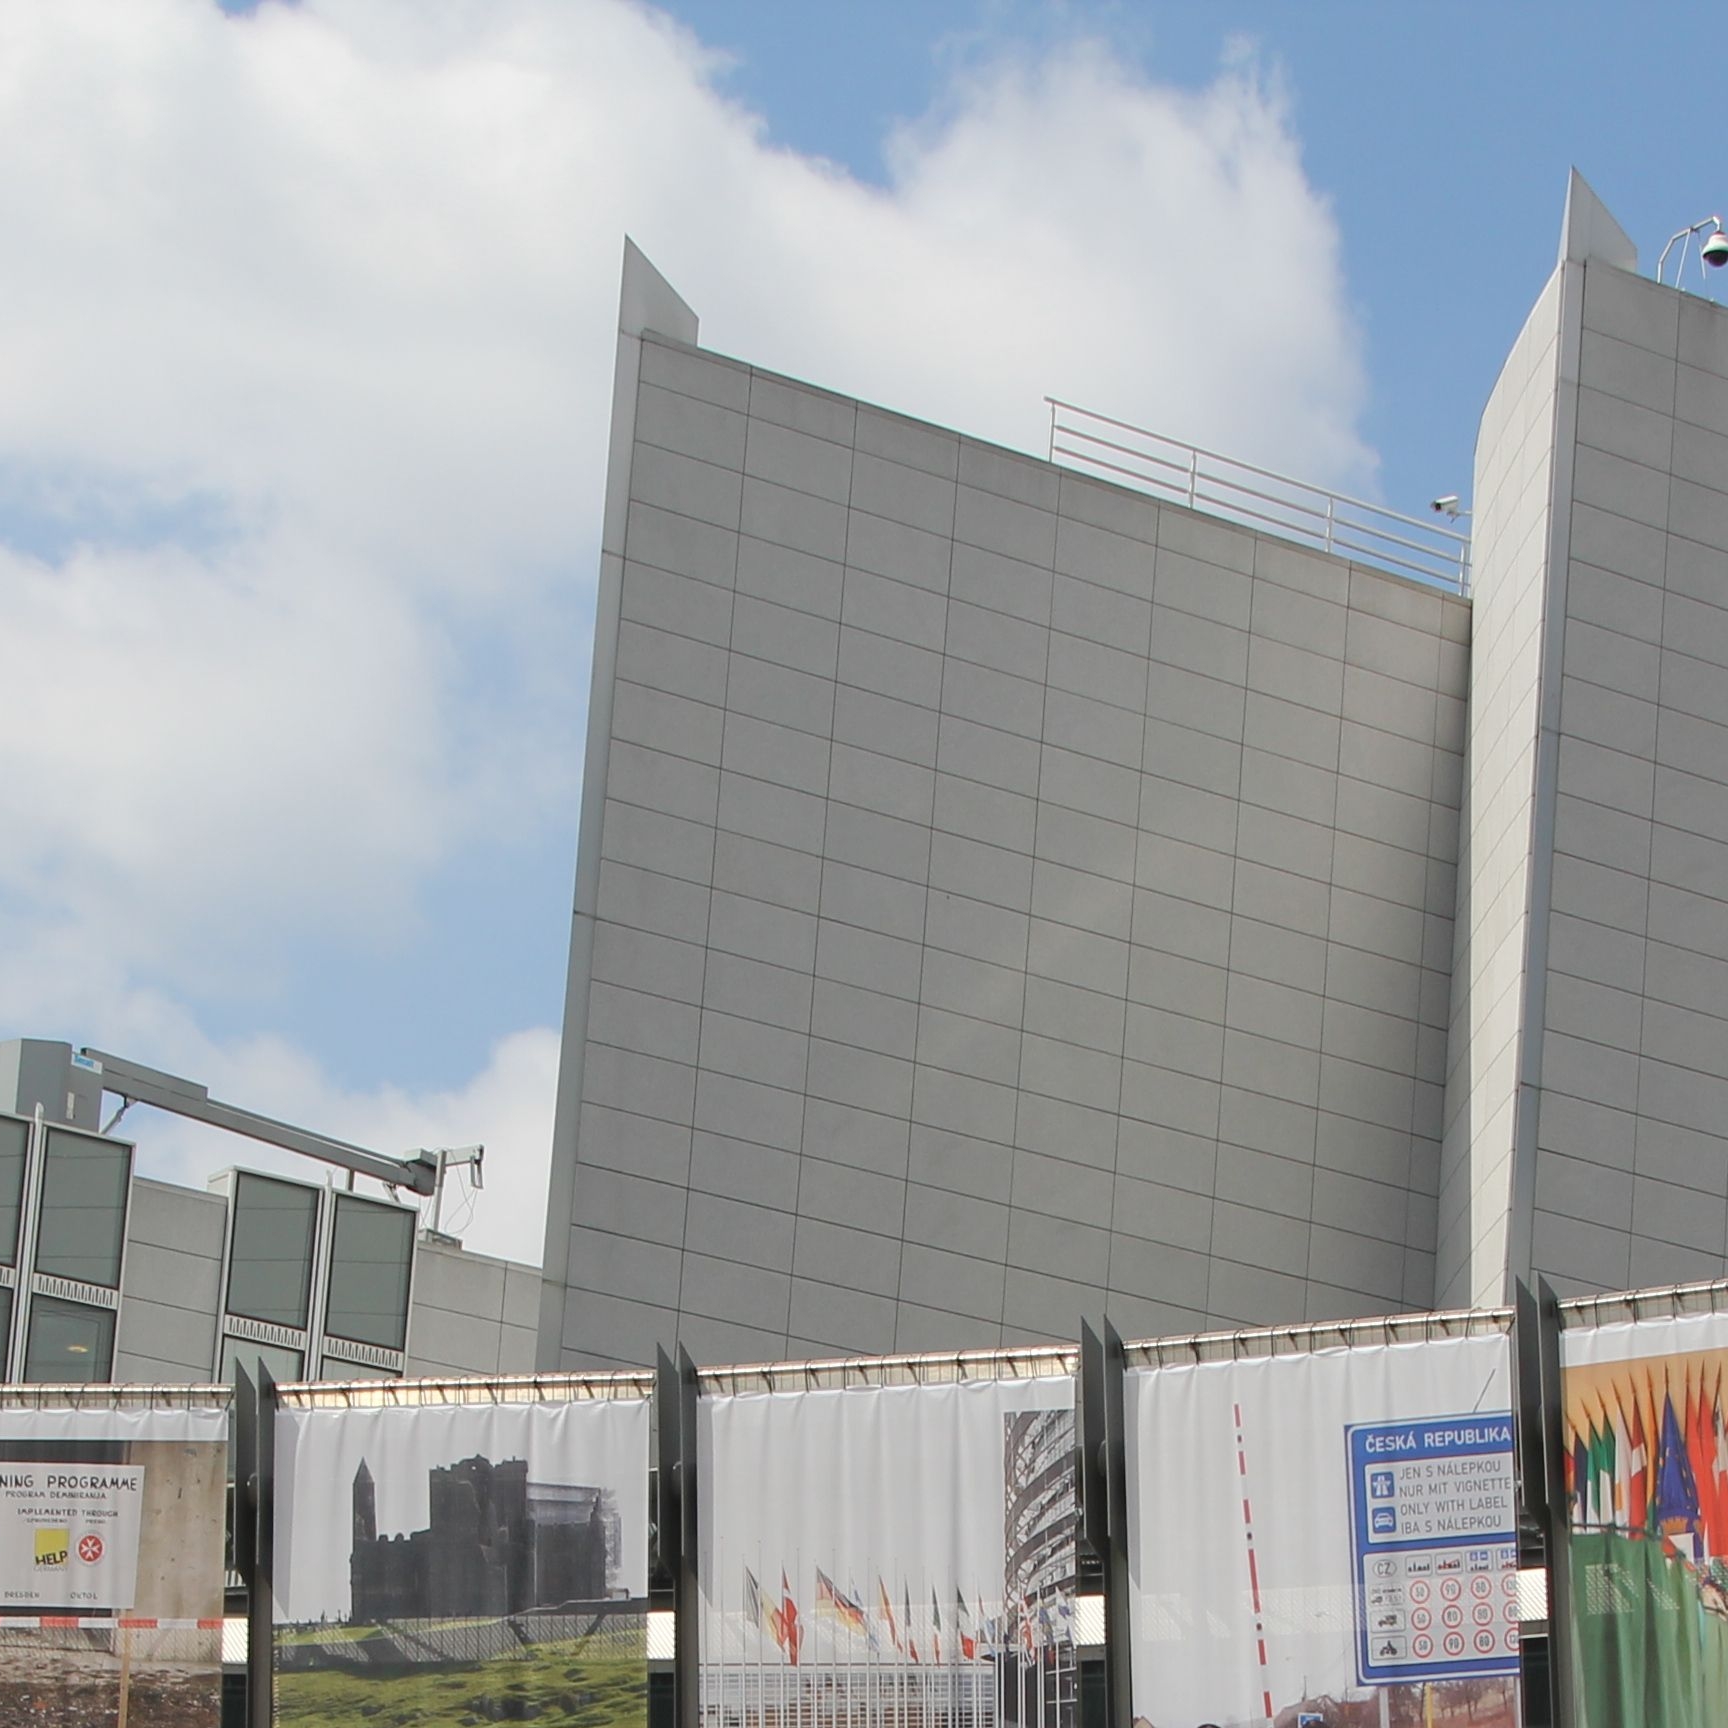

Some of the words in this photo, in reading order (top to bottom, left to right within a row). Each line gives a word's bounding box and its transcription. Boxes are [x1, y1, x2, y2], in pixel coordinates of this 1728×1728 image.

[1365, 1431, 1416, 1453] ČESKÁ
[1424, 1426, 1511, 1448] REPUBLIKA
[1399, 1465, 1421, 1481] JEN
[1425, 1463, 1433, 1478] S
[1437, 1459, 1501, 1476] NÁLEPKOU
[47, 1475, 137, 1491] PROGRAMME
[1399, 1483, 1424, 1498] NUR
[1428, 1482, 1448, 1496] MIT
[1454, 1476, 1512, 1493] VIGNETTE
[17, 1507, 78, 1517] IMPLEMENTED
[1400, 1502, 1430, 1516] ONLY
[1435, 1499, 1465, 1513] WITH
[1469, 1496, 1507, 1510] LABEL
[1401, 1519, 1420, 1535] IBA
[1425, 1518, 1433, 1533] S
[1437, 1514, 1501, 1531] NÁLEPKOU
[35, 1550, 68, 1565] HELP
[1377, 1562, 1391, 1576] CZ
[1445, 1583, 1456, 1595] 90
[1448, 1637, 1459, 1649] 90
